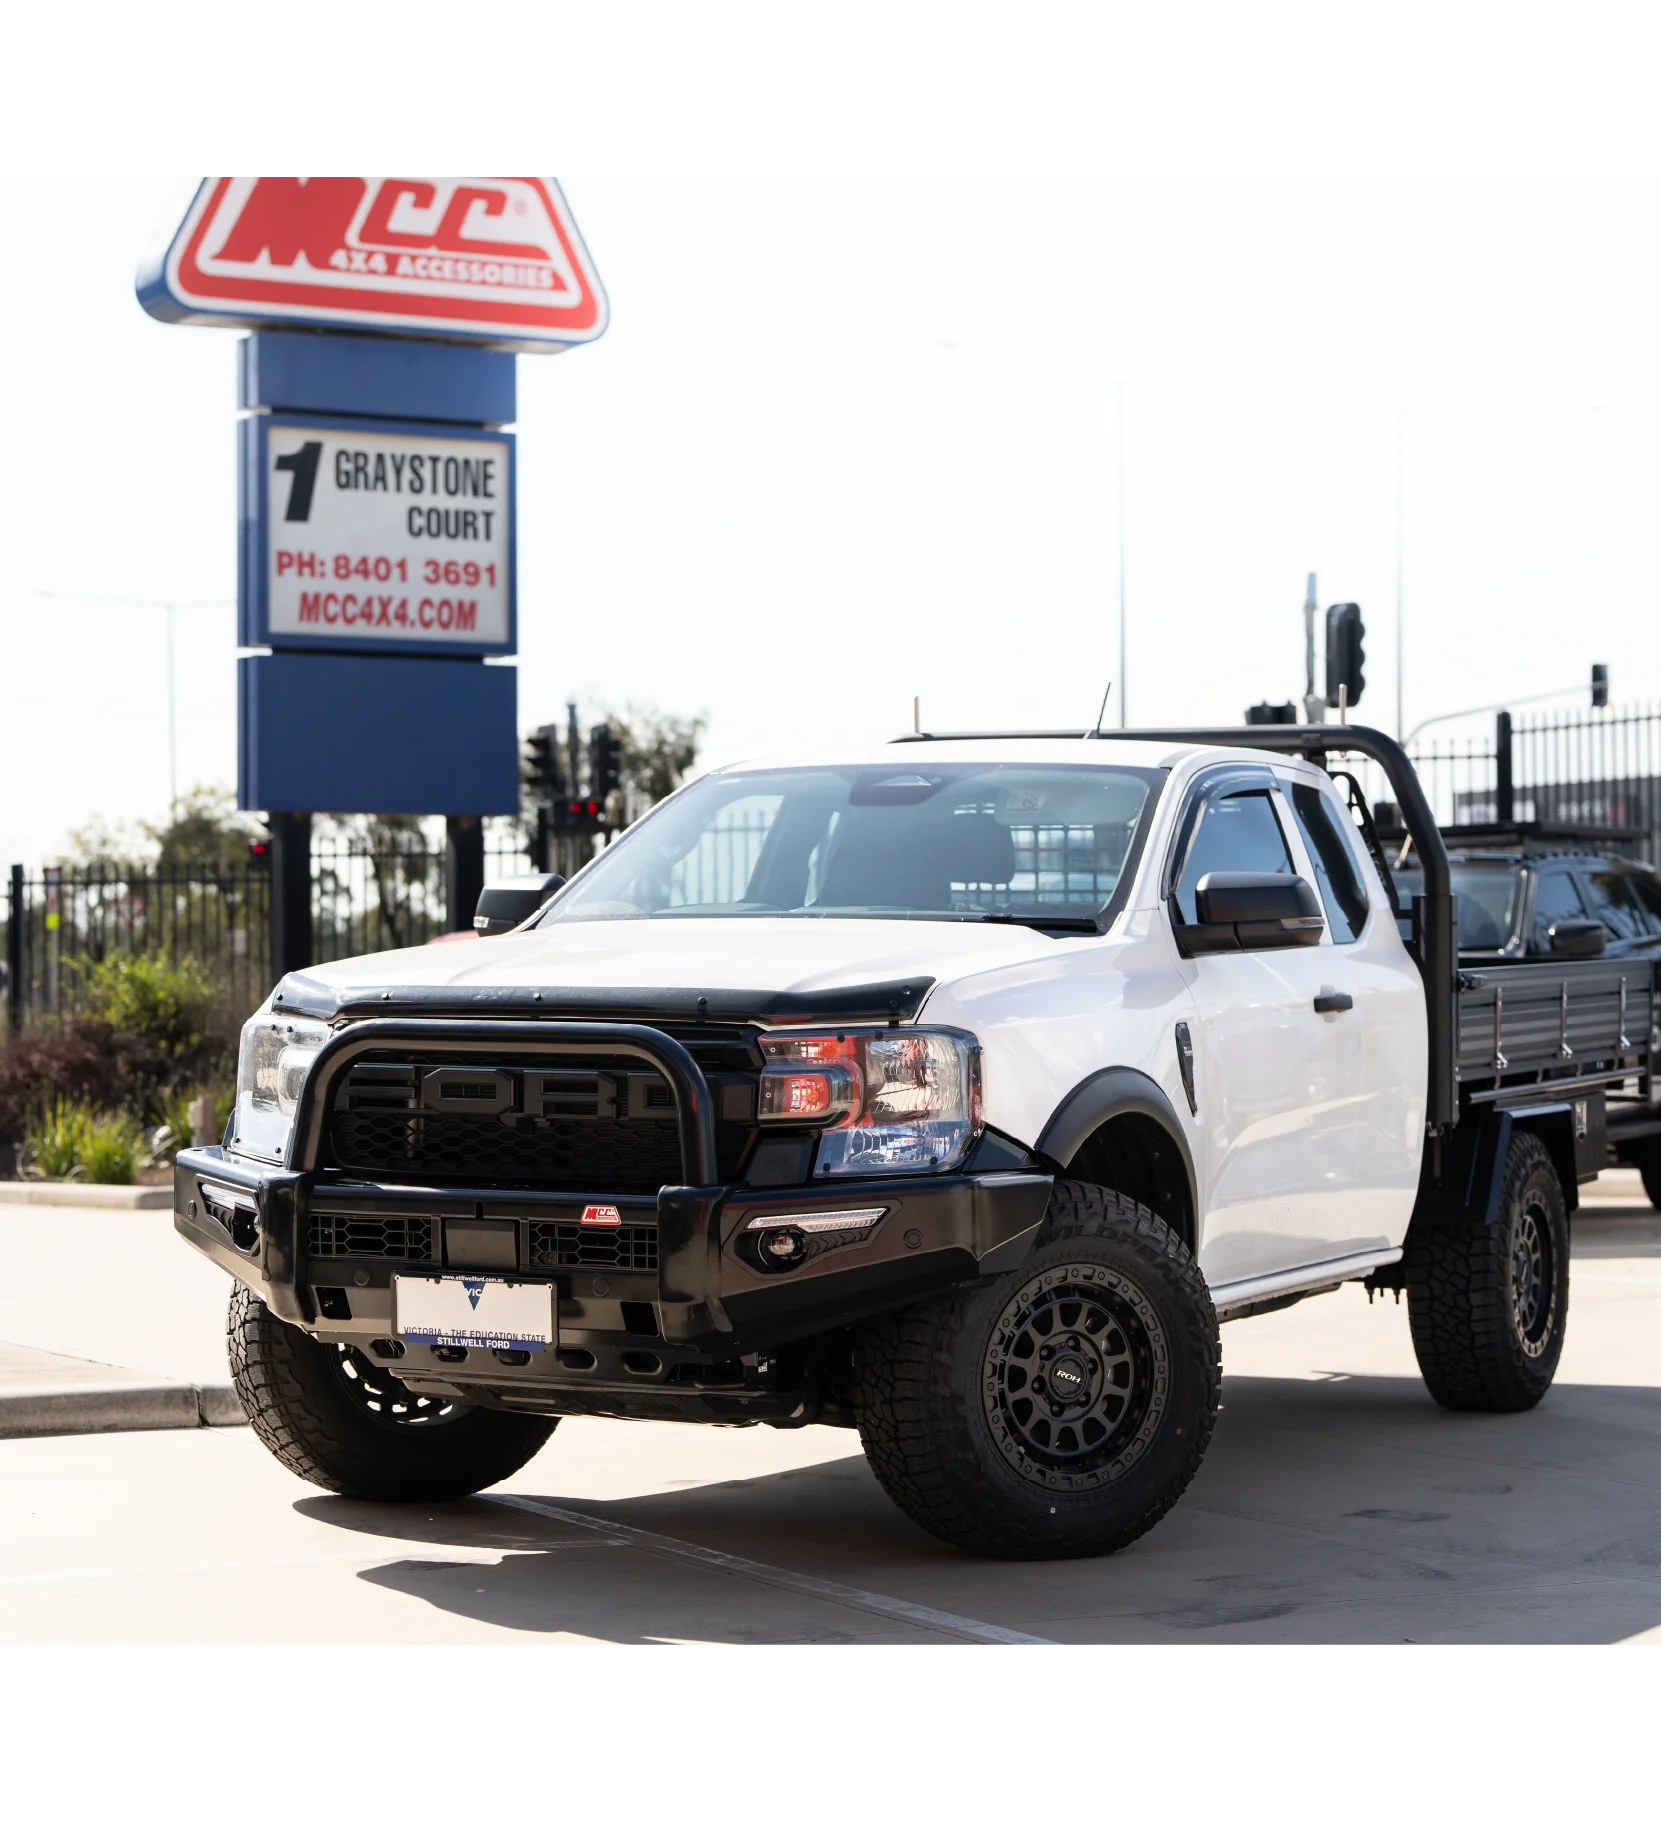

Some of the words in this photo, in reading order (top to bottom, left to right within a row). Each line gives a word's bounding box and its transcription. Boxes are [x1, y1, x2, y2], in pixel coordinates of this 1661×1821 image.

[211, 176, 552, 268] MCC
[329, 248, 388, 275] 4X4
[396, 256, 554, 291] ACCESSORIES
[274, 441, 324, 523] 1
[335, 449, 496, 499] GRAYSTONE
[407, 506, 496, 542] COURT
[276, 551, 326, 579] PH:
[332, 553, 408, 584] 8401
[423, 558, 497, 589] 3691
[297, 591, 478, 632] MCC4X4.COM
[585, 1207, 615, 1220] MCC
[442, 1275, 504, 1283] www.stillwellford.com.au
[465, 1288, 482, 1297] VIC
[404, 1326, 442, 1336] VICTORIA
[451, 1329, 467, 1338] THE
[470, 1330, 518, 1341] EDUCATION
[521, 1333, 546, 1342] STATE
[437, 1336, 484, 1348] STILLWELL
[486, 1340, 510, 1349] FORD
[1056, 1370, 1082, 1384] ROH
